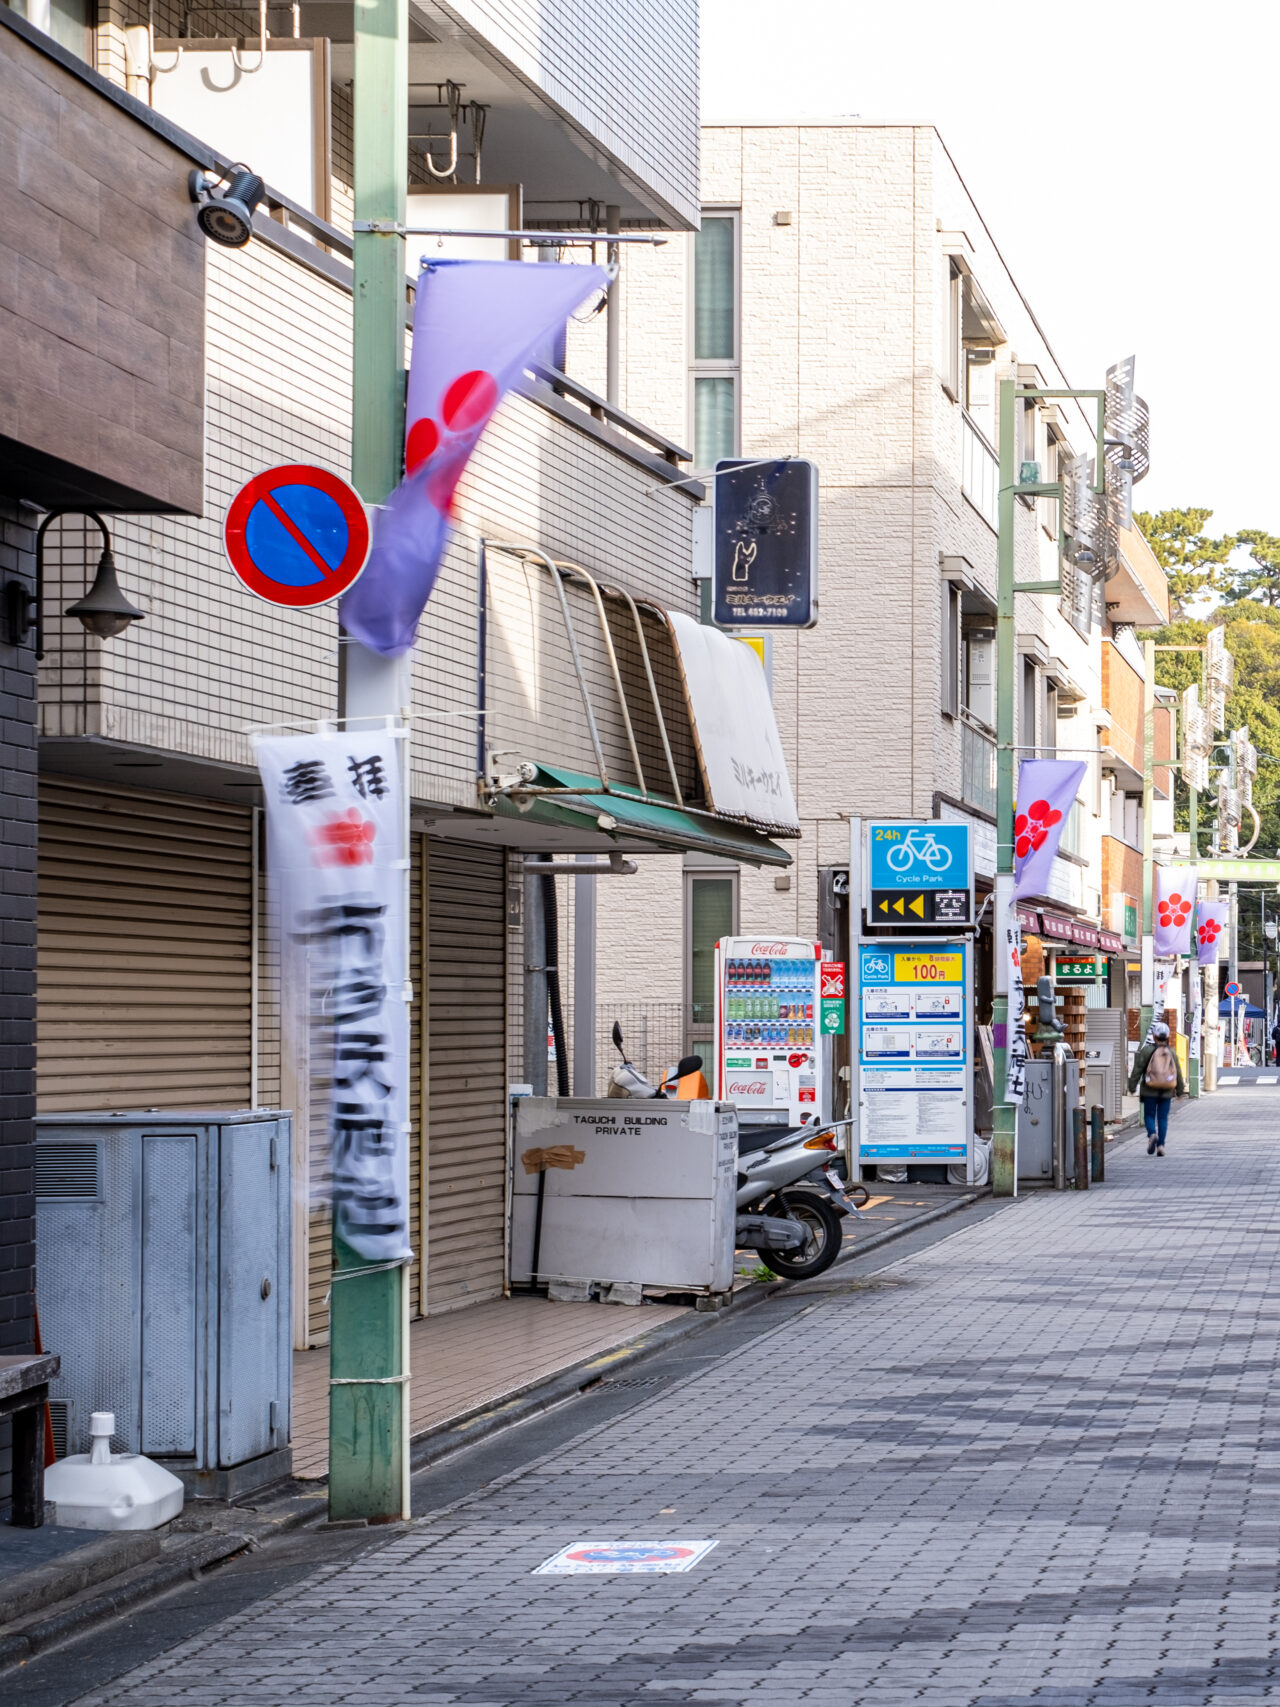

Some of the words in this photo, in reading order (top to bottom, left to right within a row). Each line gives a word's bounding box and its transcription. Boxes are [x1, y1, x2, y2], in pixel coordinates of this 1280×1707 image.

[875, 829, 901, 841] 24h
[896, 874, 920, 883] Cycle
[923, 874, 944, 882] Park
[936, 889, 966, 920] 空
[913, 964, 945, 979] 100円
[1062, 964, 1103, 974] まるよ
[573, 1115, 616, 1125] TAGUCHI
[624, 1116, 668, 1126] BUILDING
[595, 1126, 641, 1136] PRIVATE
